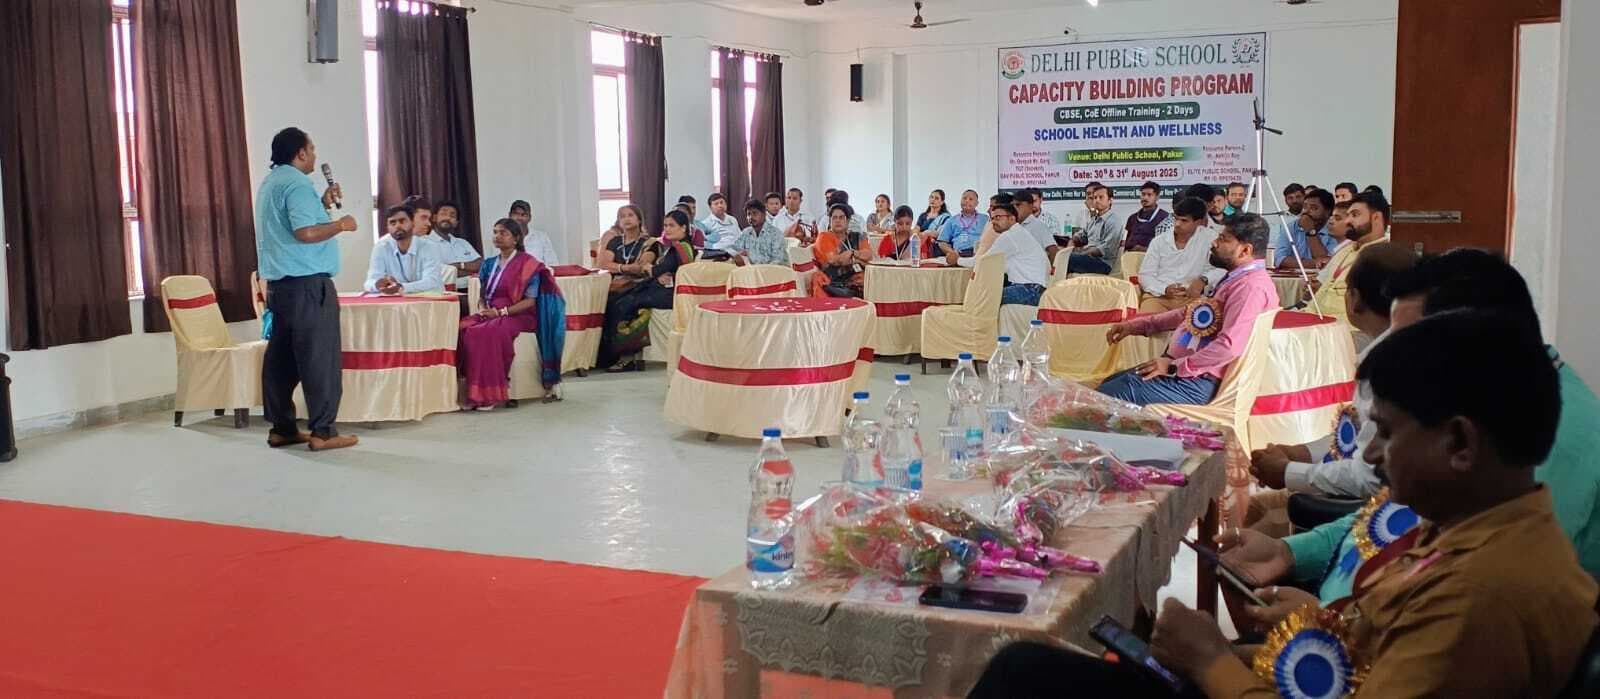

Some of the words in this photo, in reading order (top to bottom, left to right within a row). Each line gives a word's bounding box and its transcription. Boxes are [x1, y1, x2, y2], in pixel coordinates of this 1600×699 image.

[1031, 51, 1081, 73] DELHI
[1087, 48, 1149, 69] PUBLIC
[1155, 43, 1226, 67] SCHOOL
[1009, 81, 1085, 104] CAPACITY
[1089, 77, 1165, 100] BUILDING
[1170, 72, 1253, 96] PROGRAM
[1059, 109, 1082, 120] CBSE,
[1085, 108, 1099, 118] CoE
[1101, 107, 1126, 117] Offline
[1128, 106, 1160, 118] Training
[1166, 106, 1172, 115] 2
[1174, 105, 1194, 116] Days
[1034, 127, 1079, 141] SCHOOL
[1083, 125, 1127, 139] HEALTH
[1131, 124, 1155, 138] AND
[1159, 122, 1222, 137] WELLNESS
[1067, 152, 1092, 161] Venue:
[1093, 151, 1110, 160] Delhi
[1112, 151, 1133, 160] Public
[1162, 150, 1184, 158] Pakur
[1073, 169, 1092, 179] Date:
[1109, 169, 1114, 178] &
[1131, 169, 1157, 179] August
[1159, 167, 1178, 177] 2025
